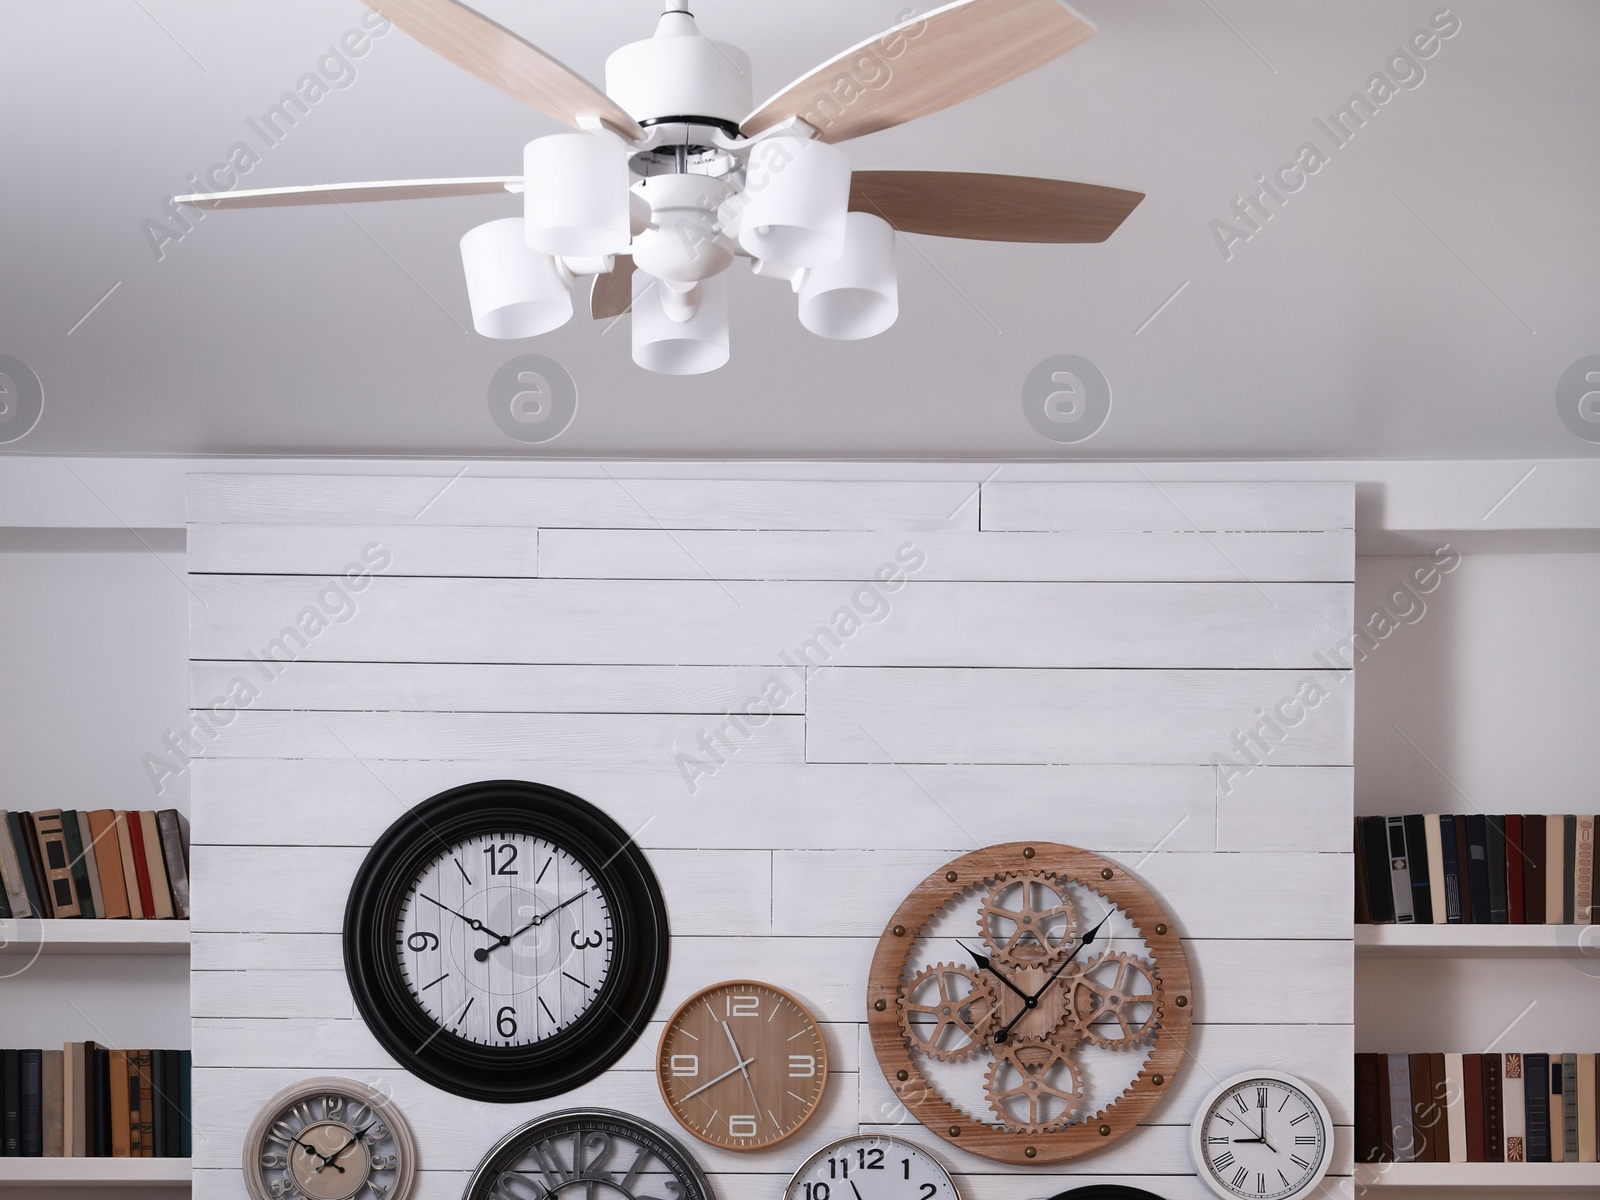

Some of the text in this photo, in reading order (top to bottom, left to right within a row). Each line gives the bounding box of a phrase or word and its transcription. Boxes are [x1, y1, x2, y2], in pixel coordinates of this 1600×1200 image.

[483, 844, 518, 876] 12
[407, 931, 439, 953] 9
[570, 929, 603, 950] 3
[726, 995, 760, 1017] 12
[496, 1006, 517, 1038] 6
[671, 1054, 698, 1077] 9
[788, 1055, 816, 1077] 3
[288, 1101, 315, 1126] 11
[318, 1095, 343, 1121] 12
[350, 1102, 369, 1125] 1
[1232, 1093, 1249, 1114] XI
[1278, 1094, 1290, 1113] I
[729, 1115, 757, 1137] 6
[1215, 1112, 1235, 1127] X
[1289, 1112, 1310, 1127] II
[265, 1121, 297, 1147] 10
[1208, 1136, 1229, 1145] IX
[1295, 1136, 1316, 1146] III
[262, 1151, 287, 1168] 9
[371, 1154, 397, 1170] 3
[527, 1139, 574, 1189] 11
[569, 1131, 613, 1181] 12
[857, 1148, 885, 1170] 12
[1212, 1150, 1236, 1173] VIII
[1289, 1153, 1310, 1171] IV
[620, 1147, 650, 1190] 1
[828, 1157, 848, 1179] 11
[901, 1158, 910, 1180] 1
[1231, 1166, 1250, 1189] VII
[1277, 1168, 1290, 1188] V
[269, 1178, 294, 1198] 8
[367, 1179, 387, 1200] 4
[1257, 1172, 1266, 1194] VI
